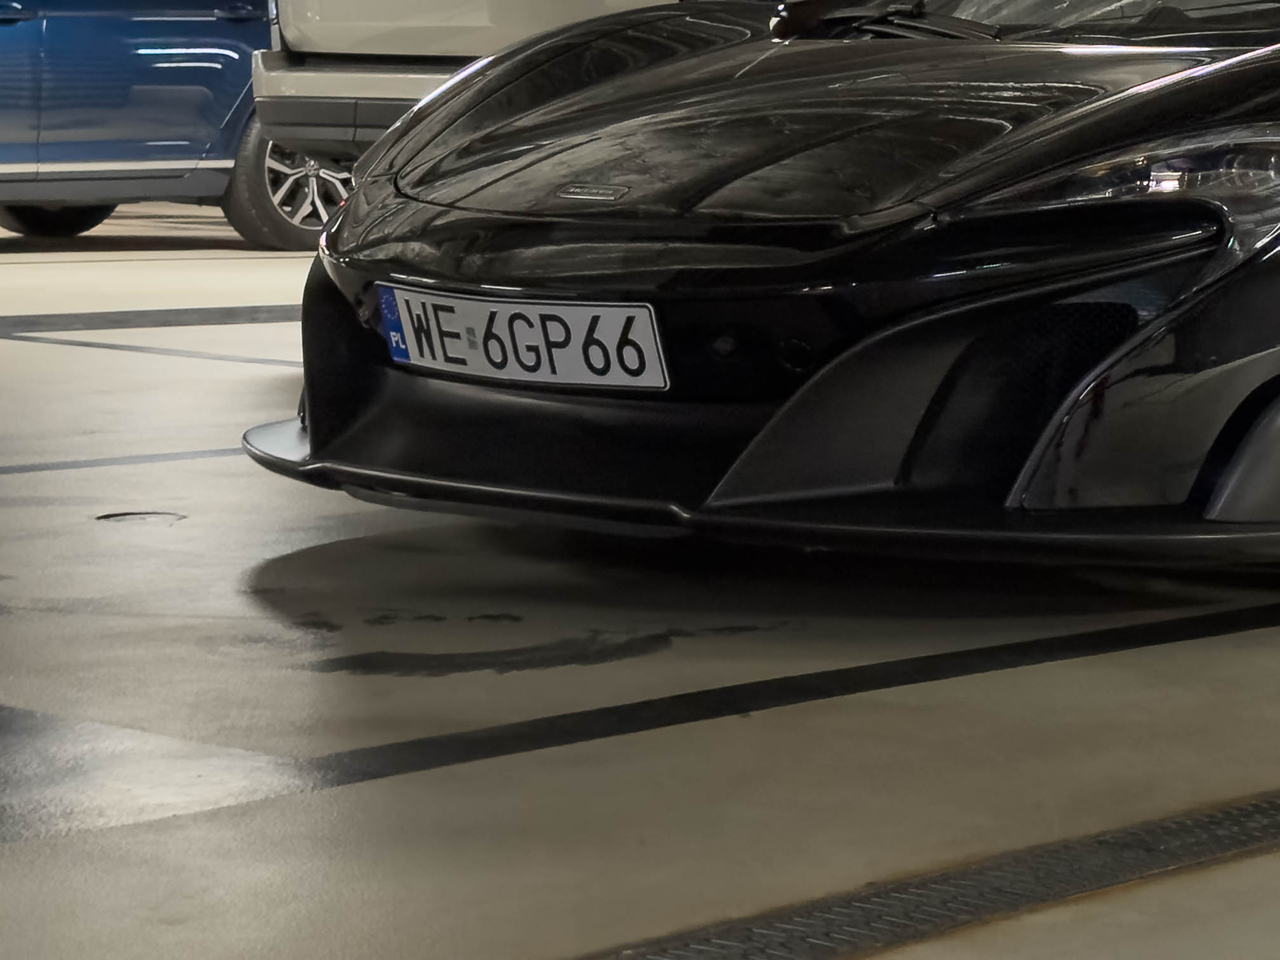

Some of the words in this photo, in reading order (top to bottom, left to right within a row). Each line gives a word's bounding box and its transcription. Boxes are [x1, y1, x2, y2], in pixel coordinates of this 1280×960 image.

[390, 331, 406, 349] PL
[404, 298, 468, 366] WE
[482, 310, 647, 377] 6GP66
